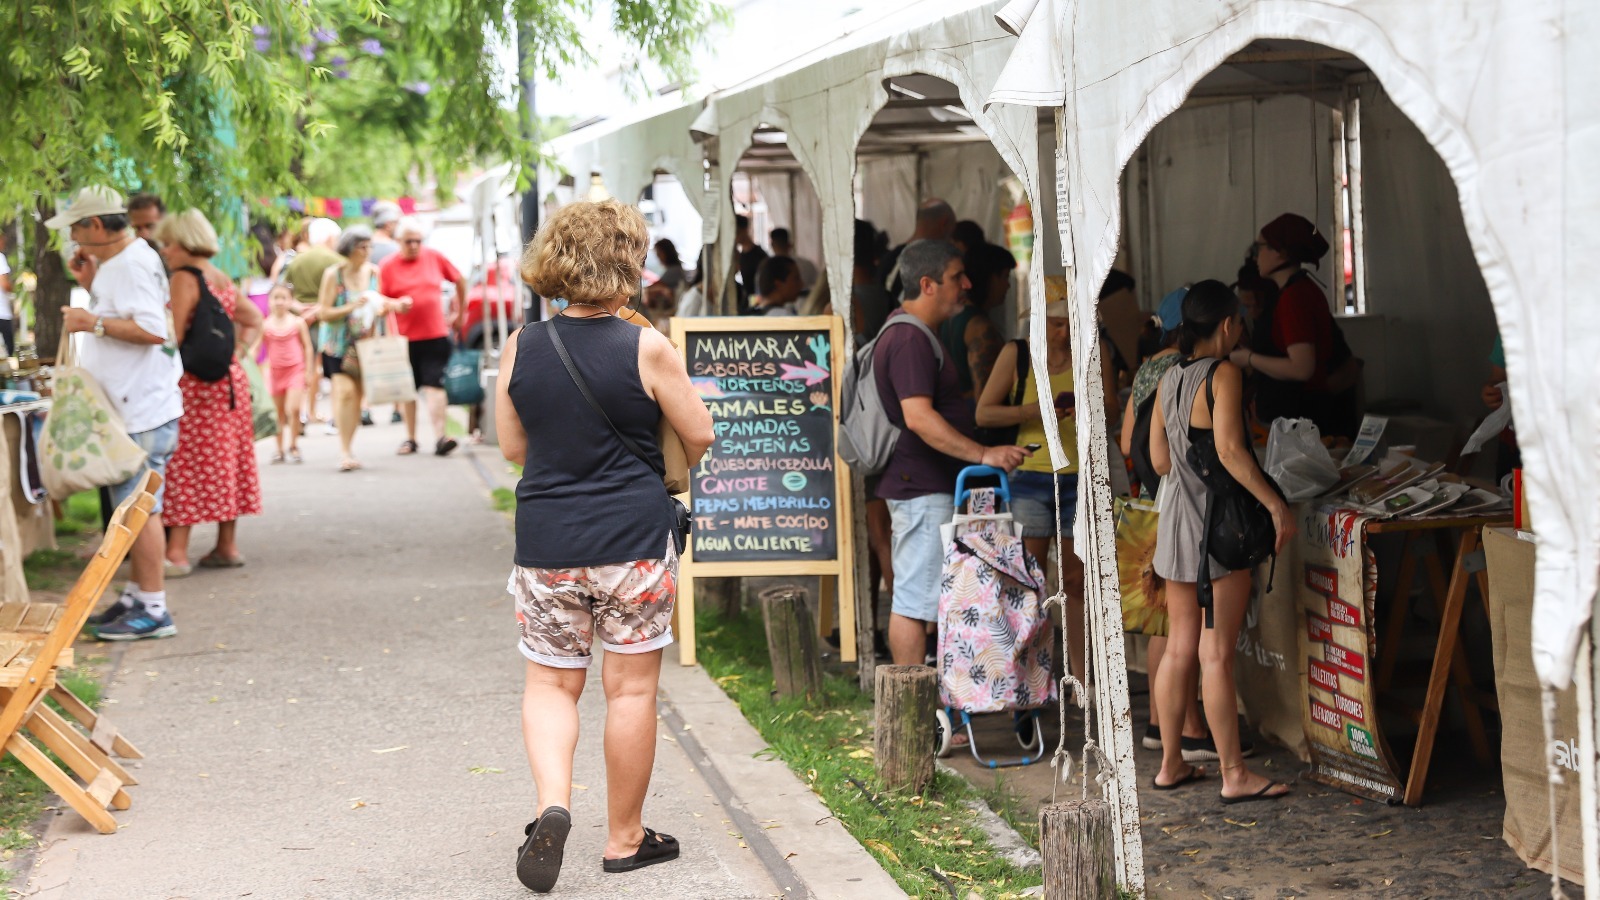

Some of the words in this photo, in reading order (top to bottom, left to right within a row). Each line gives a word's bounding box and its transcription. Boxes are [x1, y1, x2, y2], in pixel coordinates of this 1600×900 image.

[694, 361, 777, 378] SABORES
[716, 377, 806, 393] NORTEÑOS
[701, 476, 768, 495] CAYOTE
[695, 498, 740, 513] PEPAS
[743, 496, 831, 511] MEMBRILLO
[733, 515, 773, 529] MATE
[696, 536, 732, 551] AGUA
[734, 534, 813, 552] CALIENTE
[1311, 664, 1338, 689] GALLETITAS
[1334, 693, 1363, 719] TURRONES
[1312, 703, 1341, 729] ALFAJORES
[1350, 727, 1369, 746] 100%
